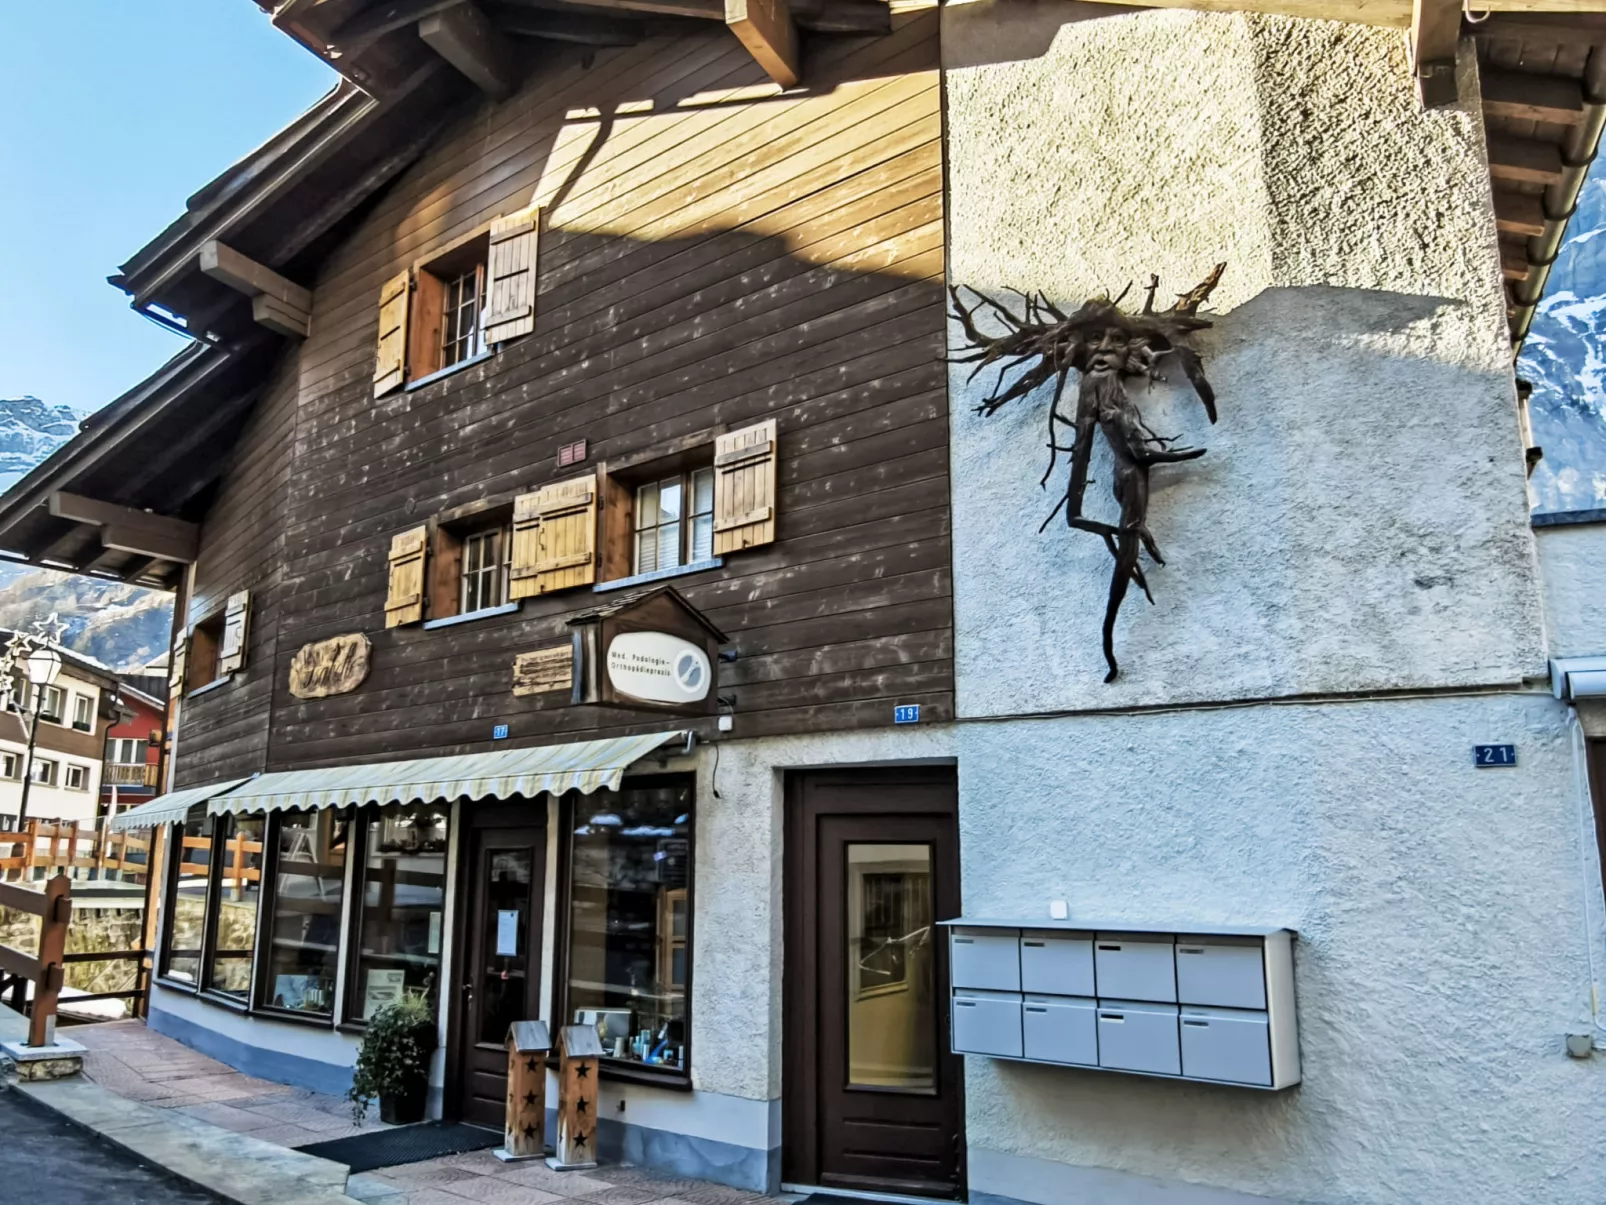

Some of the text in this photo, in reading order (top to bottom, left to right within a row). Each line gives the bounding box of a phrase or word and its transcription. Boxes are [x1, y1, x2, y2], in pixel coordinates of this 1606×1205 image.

[611, 651, 628, 660] Med.
[900, 707, 914, 720] 19
[1483, 746, 1508, 763] 21
